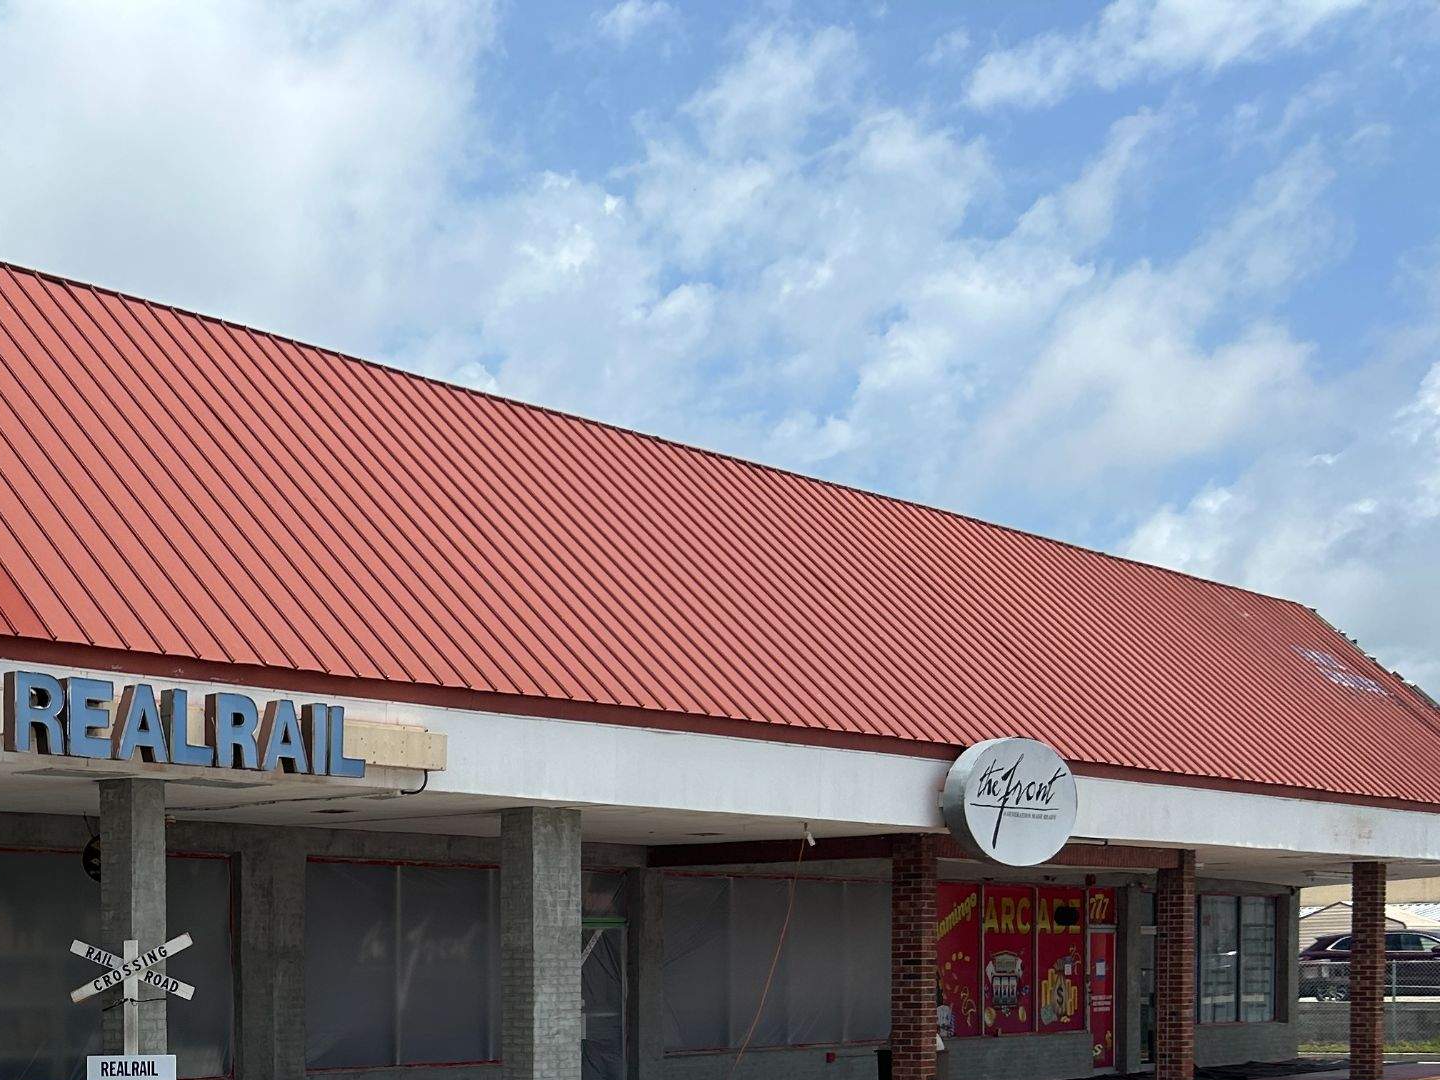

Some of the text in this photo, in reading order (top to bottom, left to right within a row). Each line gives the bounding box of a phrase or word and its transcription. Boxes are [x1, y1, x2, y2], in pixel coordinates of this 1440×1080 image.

[4, 670, 366, 779] REALRAIL
[977, 759, 1004, 798] the
[936, 891, 977, 941] lamingo
[85, 946, 114, 968] RAIL
[93, 946, 168, 992] CROSSING
[143, 970, 180, 994] ROAD
[100, 1060, 159, 1077] REALRAIL
